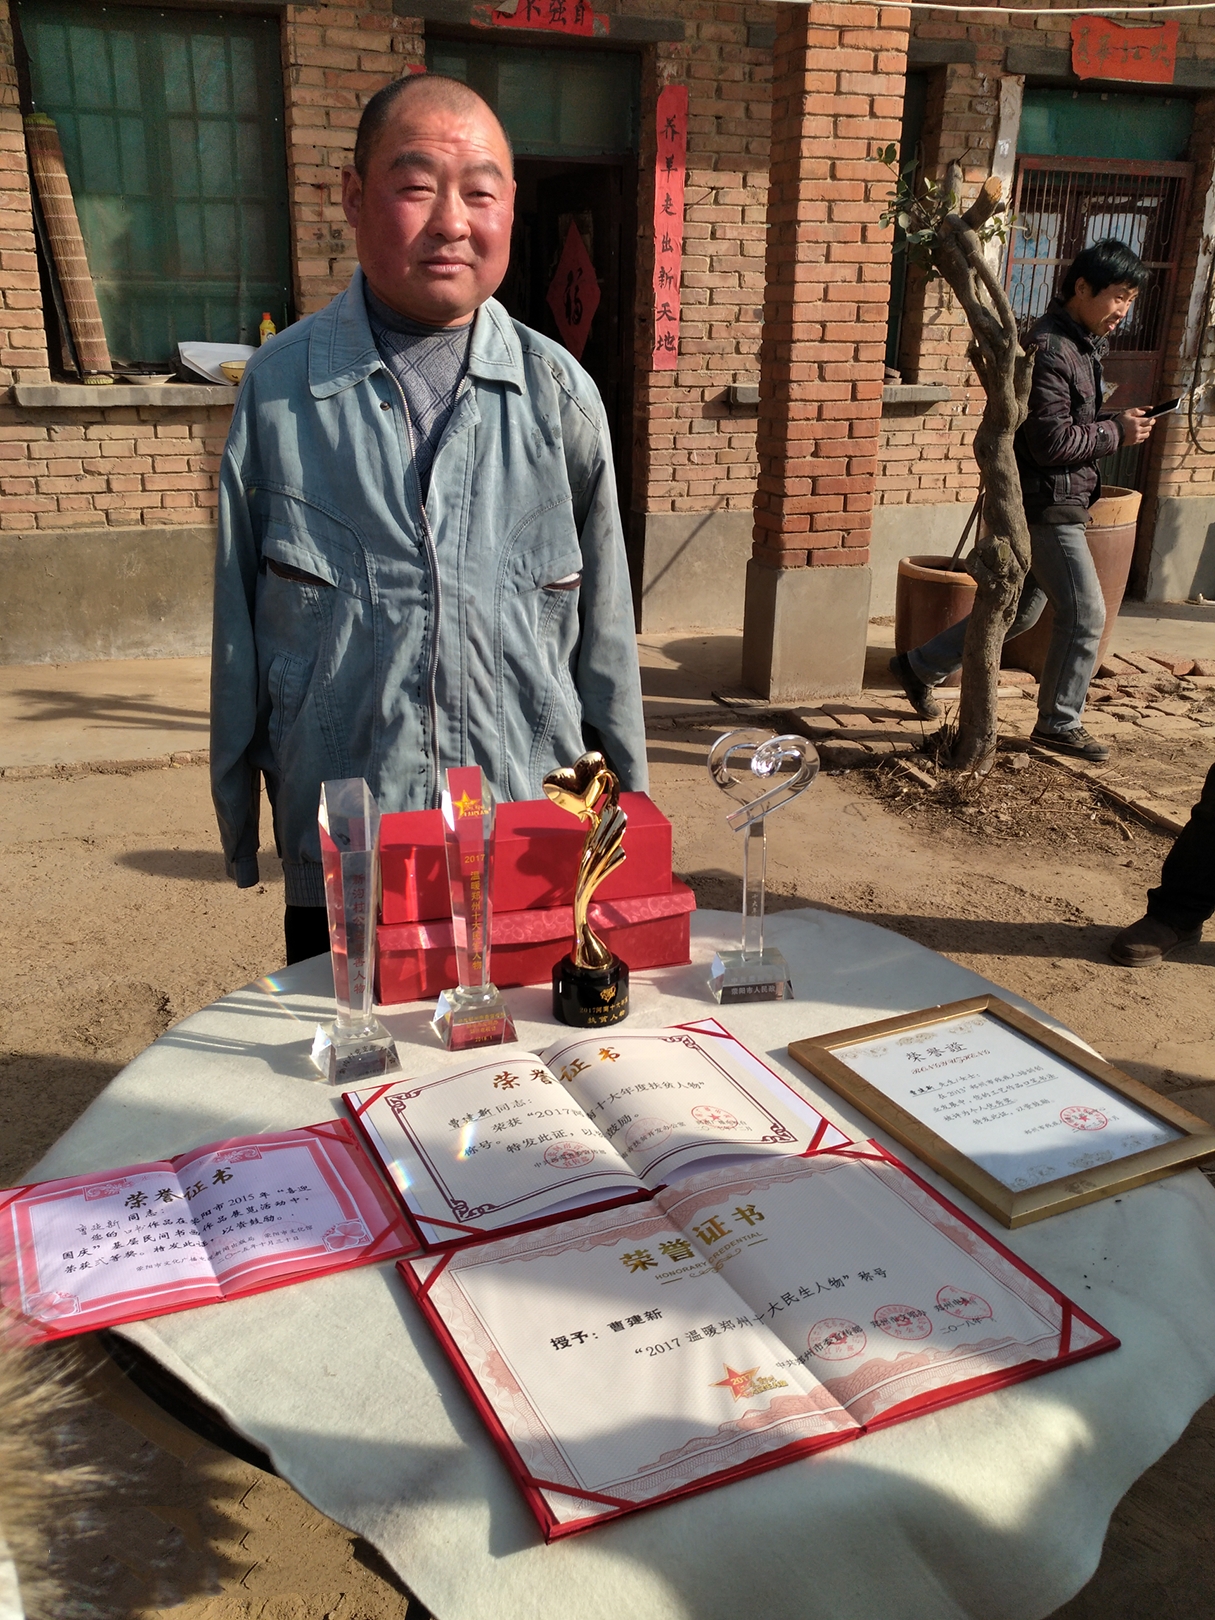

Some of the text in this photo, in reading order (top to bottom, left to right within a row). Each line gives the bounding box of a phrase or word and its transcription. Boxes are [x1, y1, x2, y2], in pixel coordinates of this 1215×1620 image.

[655, 115, 678, 352] 养羊走出新天地
[464, 854, 486, 863] 2017
[470, 870, 483, 970] 温暖郑州十大民生人物
[493, 1046, 621, 1091] 荣誉证书
[124, 1166, 234, 1210] 荣誉证书
[618, 1203, 766, 1275] 荣誉证书
[654, 1231, 763, 1281] HONORARY CREDENTIAL
[730, 1373, 752, 1387] 2017
